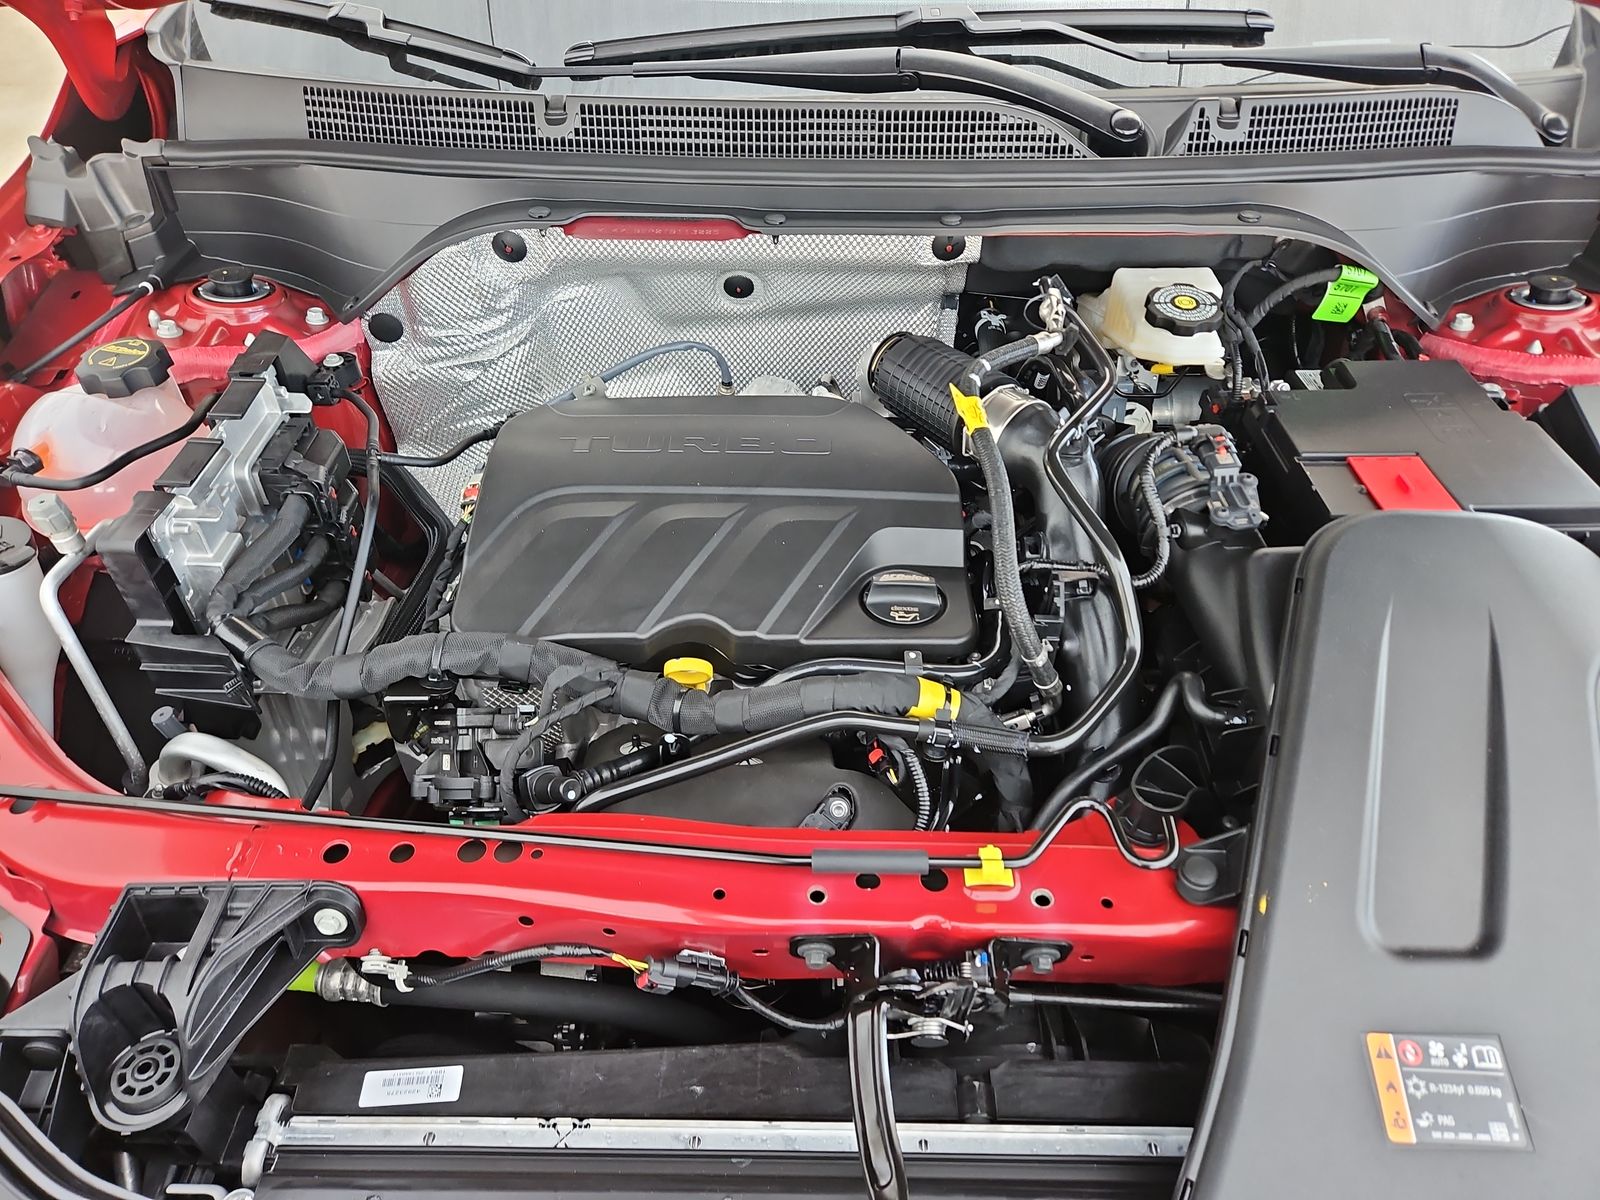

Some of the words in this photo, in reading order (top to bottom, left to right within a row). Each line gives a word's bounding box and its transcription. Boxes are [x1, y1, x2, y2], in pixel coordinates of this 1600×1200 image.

[1333, 283, 1359, 293] 5707
[559, 434, 833, 455] TURBO
[1430, 1056, 1450, 1067] AUTO
